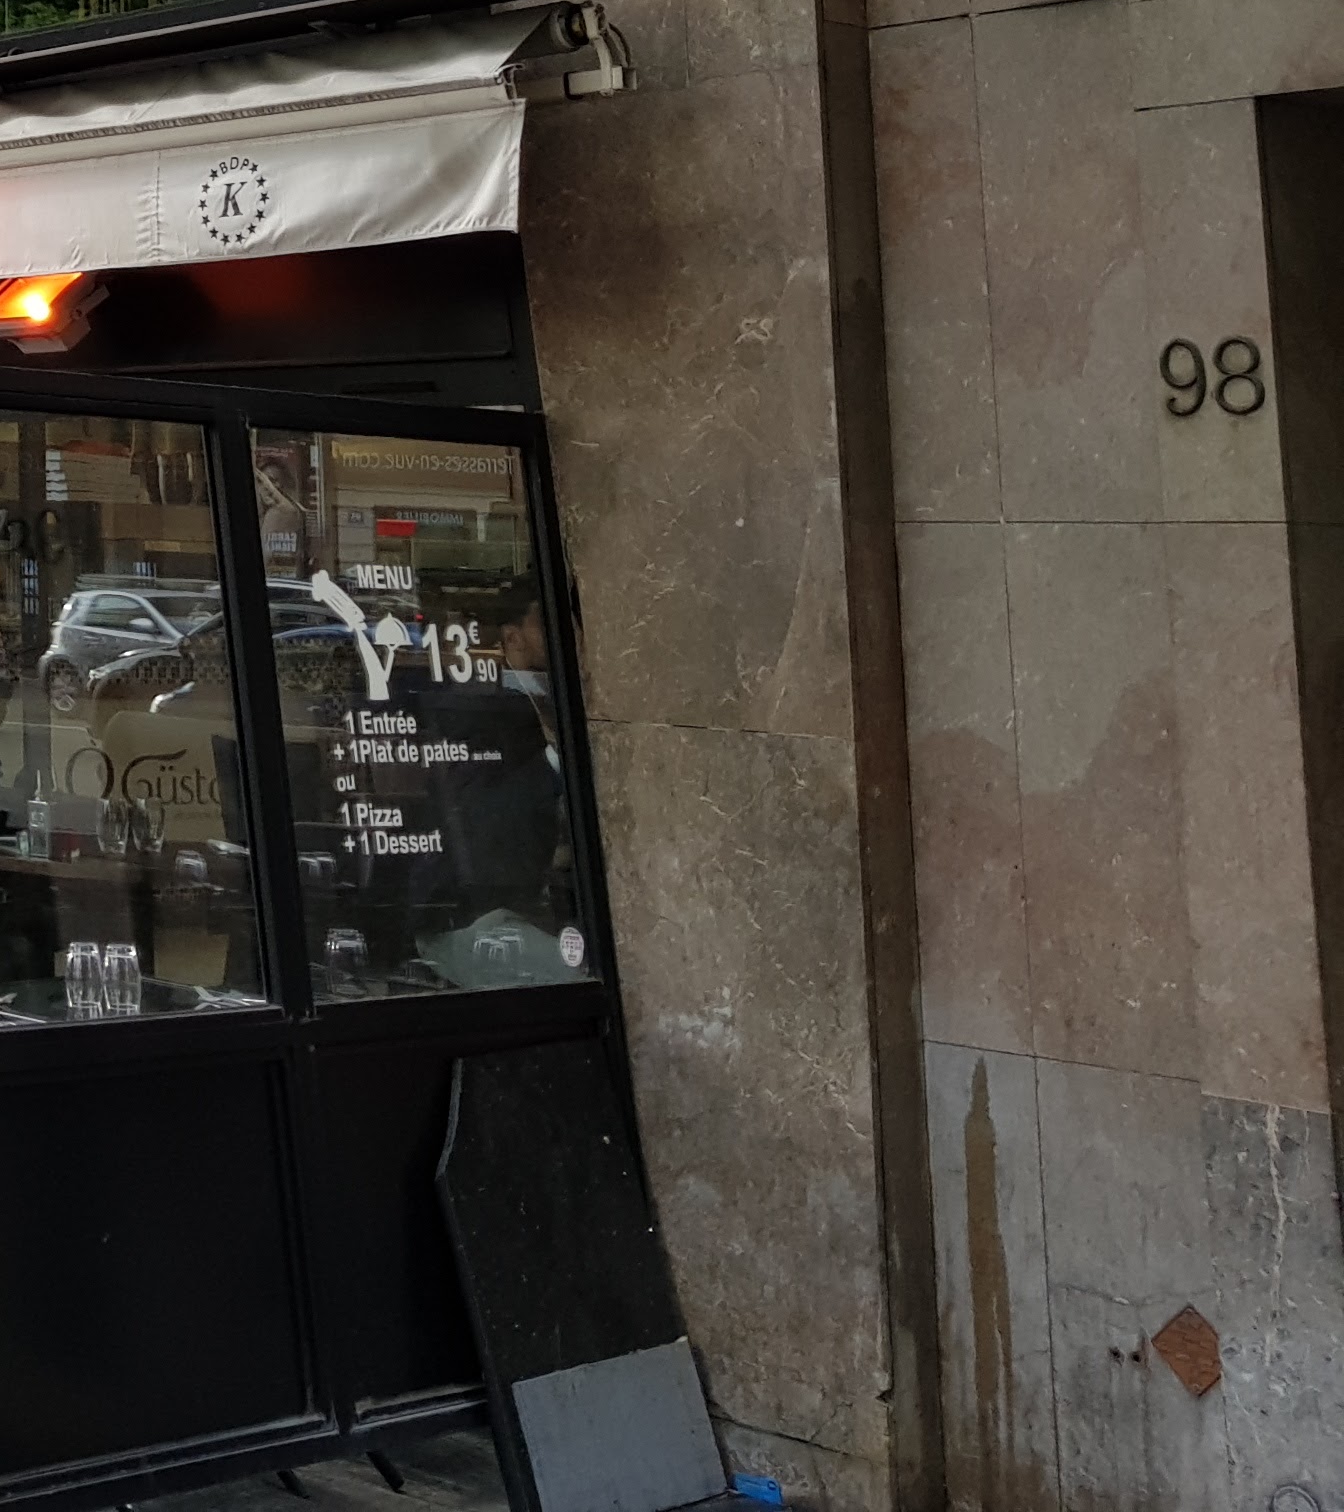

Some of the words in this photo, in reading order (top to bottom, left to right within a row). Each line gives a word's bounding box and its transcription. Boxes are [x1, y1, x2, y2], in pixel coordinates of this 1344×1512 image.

[219, 156, 250, 174] BDP
[219, 181, 248, 218] K
[1158, 334, 1267, 418] 98
[356, 564, 412, 589] MENU
[344, 711, 355, 734] 1
[359, 710, 417, 735] Entrée
[397, 739, 419, 763] de
[422, 739, 469, 768] pates
[336, 774, 356, 792] ou
[341, 802, 351, 827] 1
[356, 802, 403, 827] Pizza
[360, 831, 370, 855] 1
[374, 829, 443, 855] Dessert
